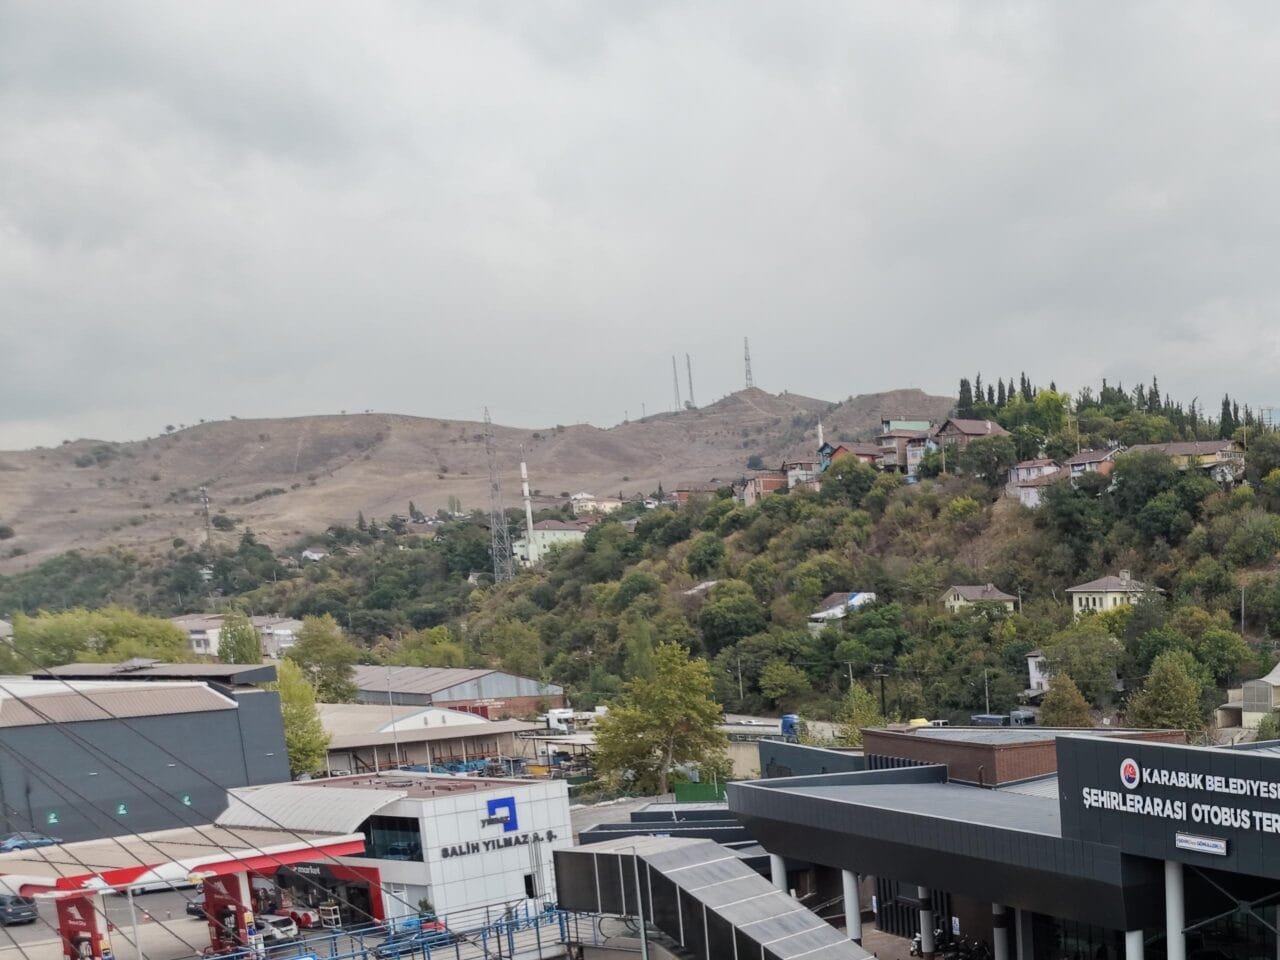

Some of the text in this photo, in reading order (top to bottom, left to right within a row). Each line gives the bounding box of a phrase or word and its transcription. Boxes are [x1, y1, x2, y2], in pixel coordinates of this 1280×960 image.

[1082, 787, 1187, 821] ŞEHİRLERARASI
[441, 840, 480, 859] SALİH
[482, 833, 529, 852] YILMAZ
